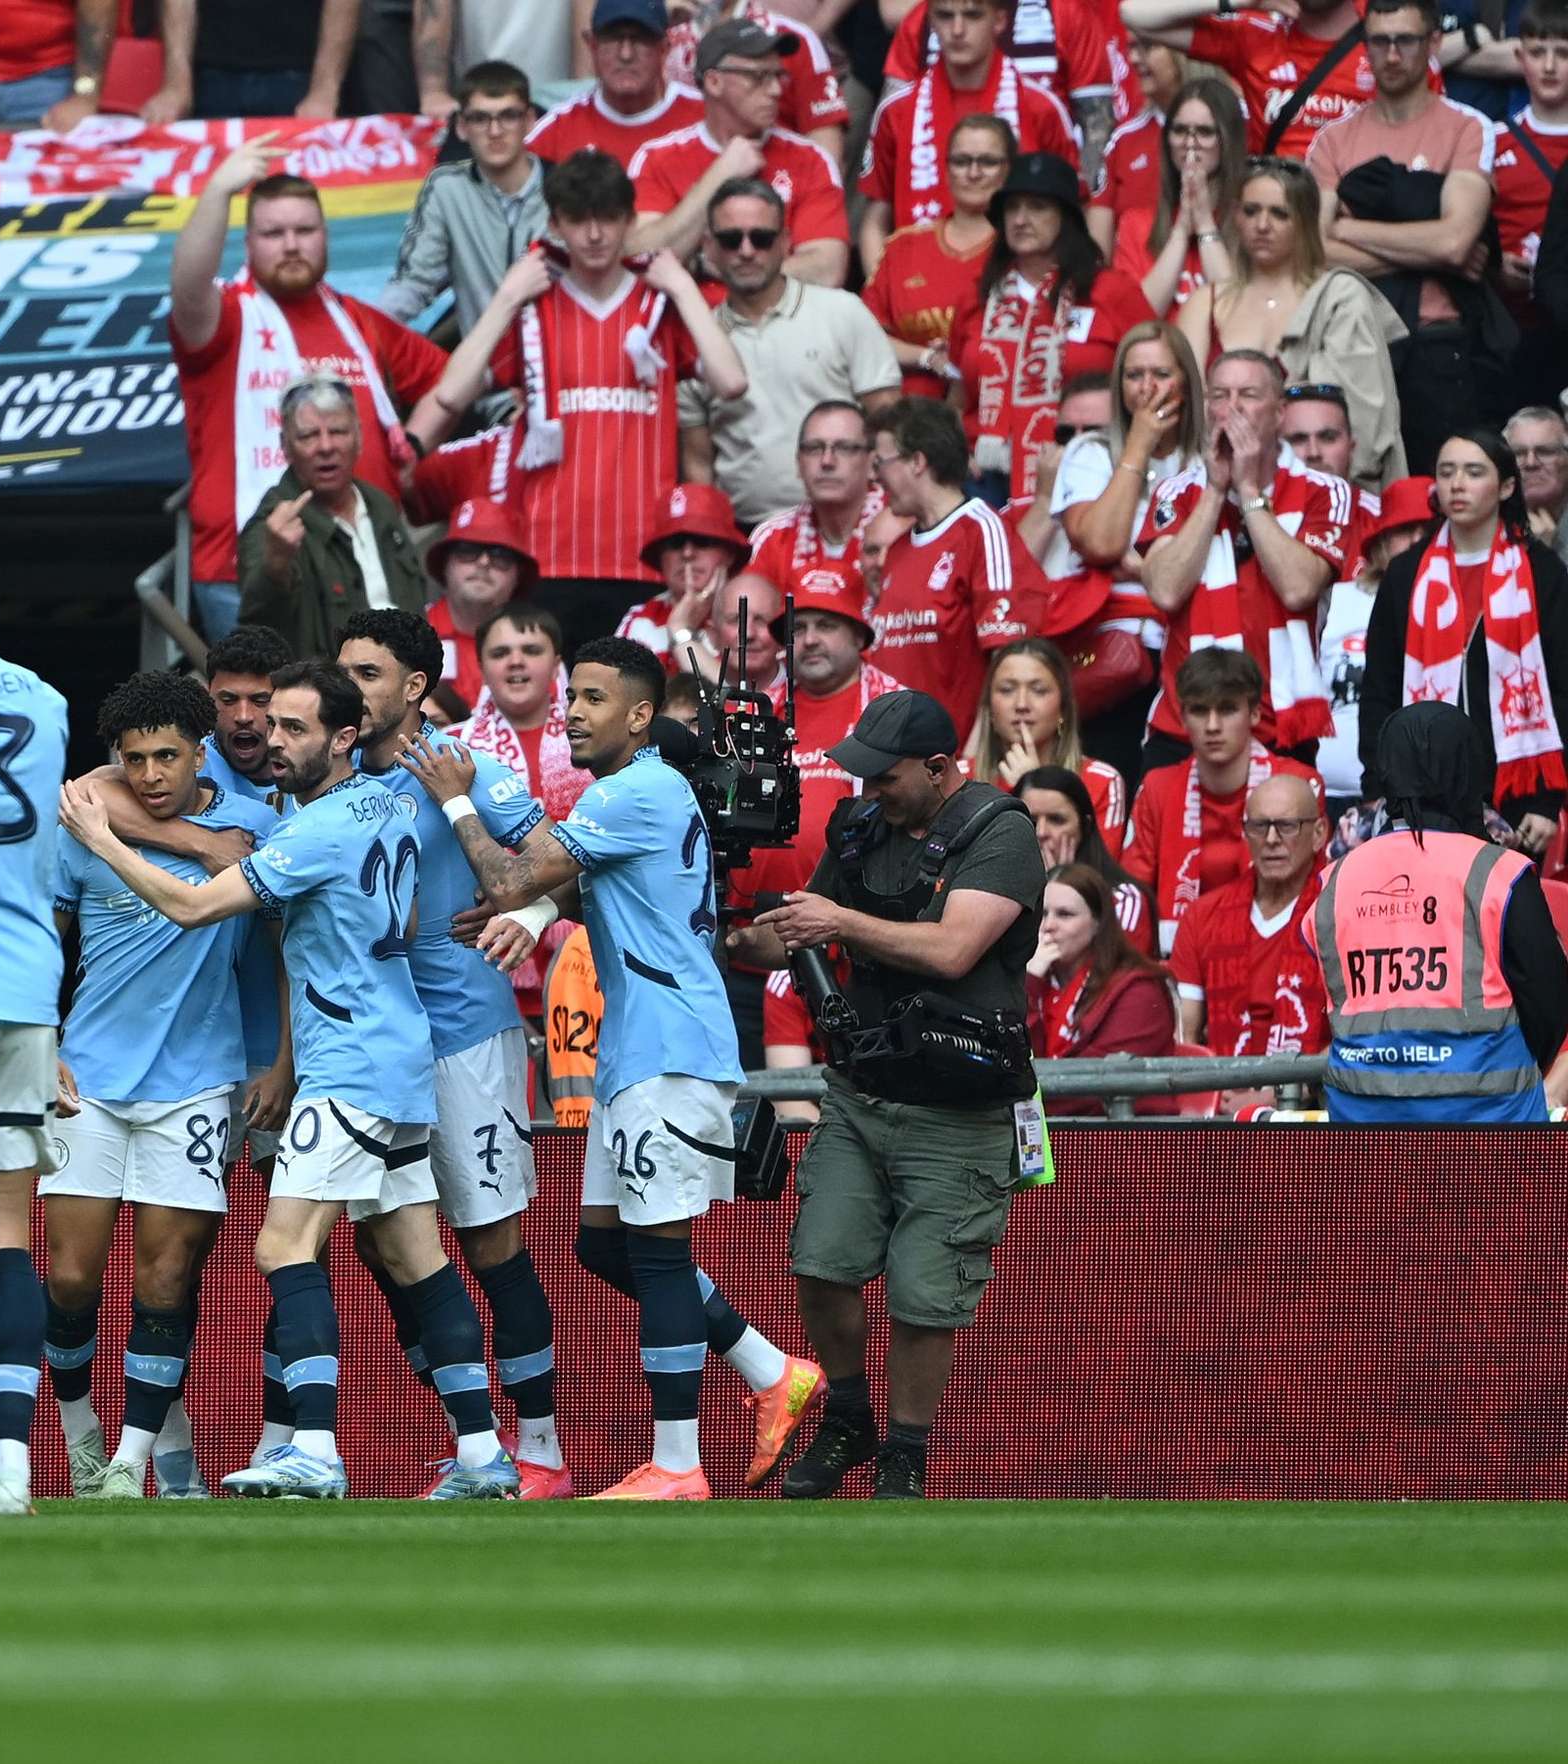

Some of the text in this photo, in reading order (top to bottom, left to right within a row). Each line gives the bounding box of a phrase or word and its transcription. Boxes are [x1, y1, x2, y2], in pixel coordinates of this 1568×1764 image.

[558, 386, 658, 416] anasonic
[254, 447, 287, 470] 186
[346, 793, 403, 824] BERNAR
[1356, 901, 1420, 919] WEMBLEY
[1347, 946, 1448, 999] RT535
[1338, 1045, 1453, 1063] HERE TO HELP
[473, 1123, 503, 1175] 7
[612, 1128, 657, 1180] 26
